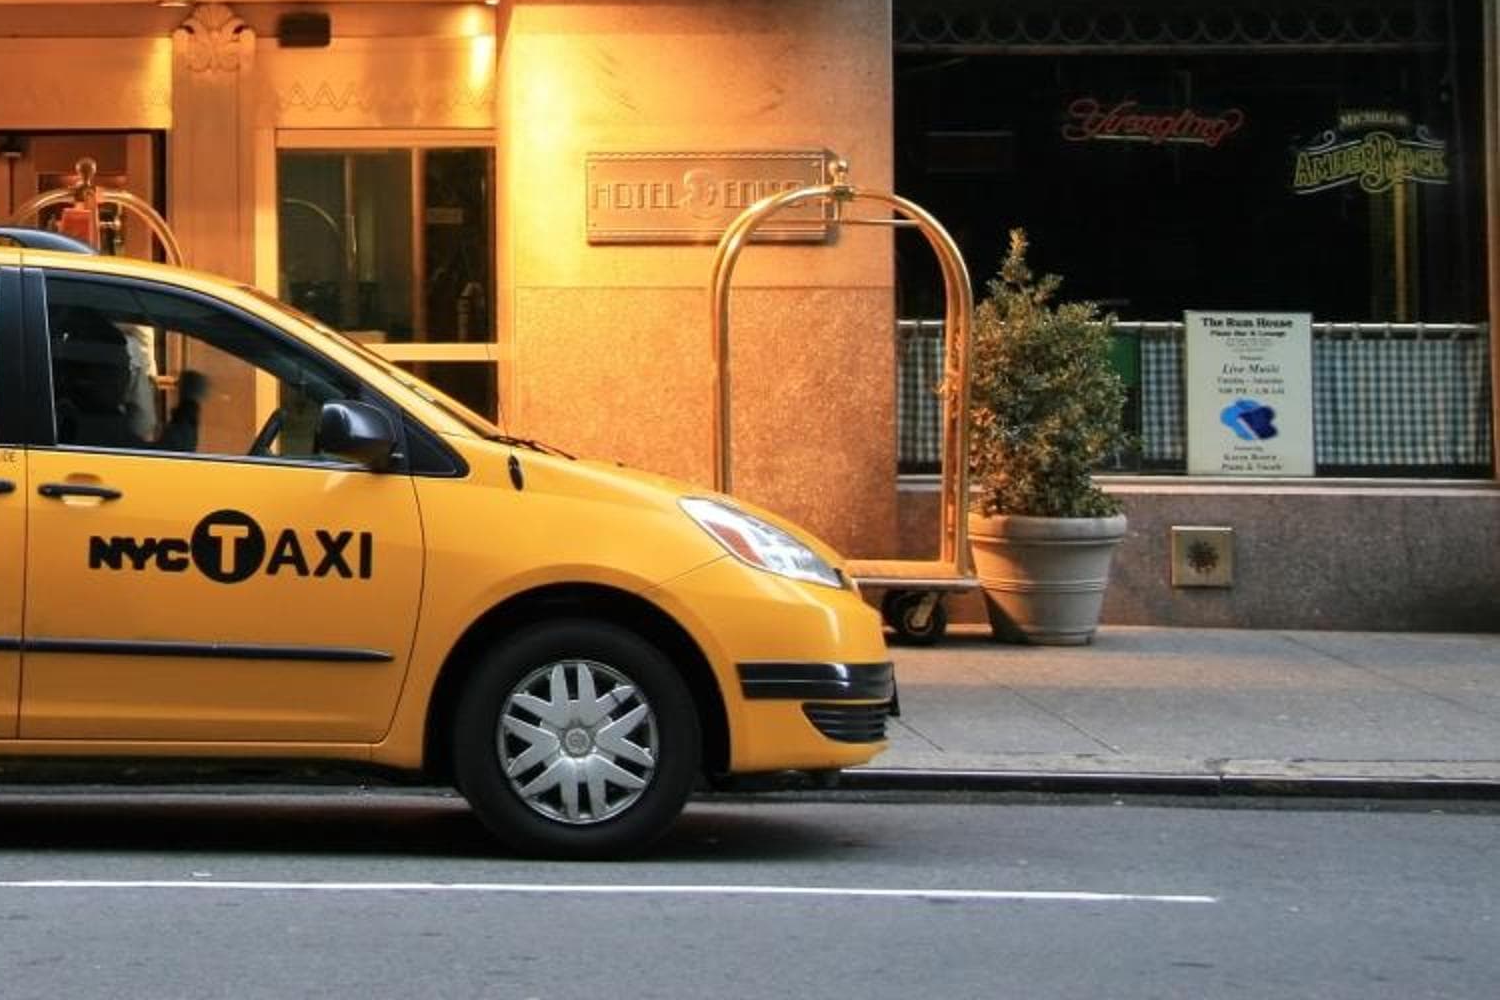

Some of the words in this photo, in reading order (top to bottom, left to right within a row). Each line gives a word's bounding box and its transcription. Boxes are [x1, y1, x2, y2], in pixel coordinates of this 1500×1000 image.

[592, 182, 677, 210] HOTEL
[1201, 317, 1223, 328] The
[89, 535, 190, 573] NYC
[192, 509, 373, 584] TAXI
